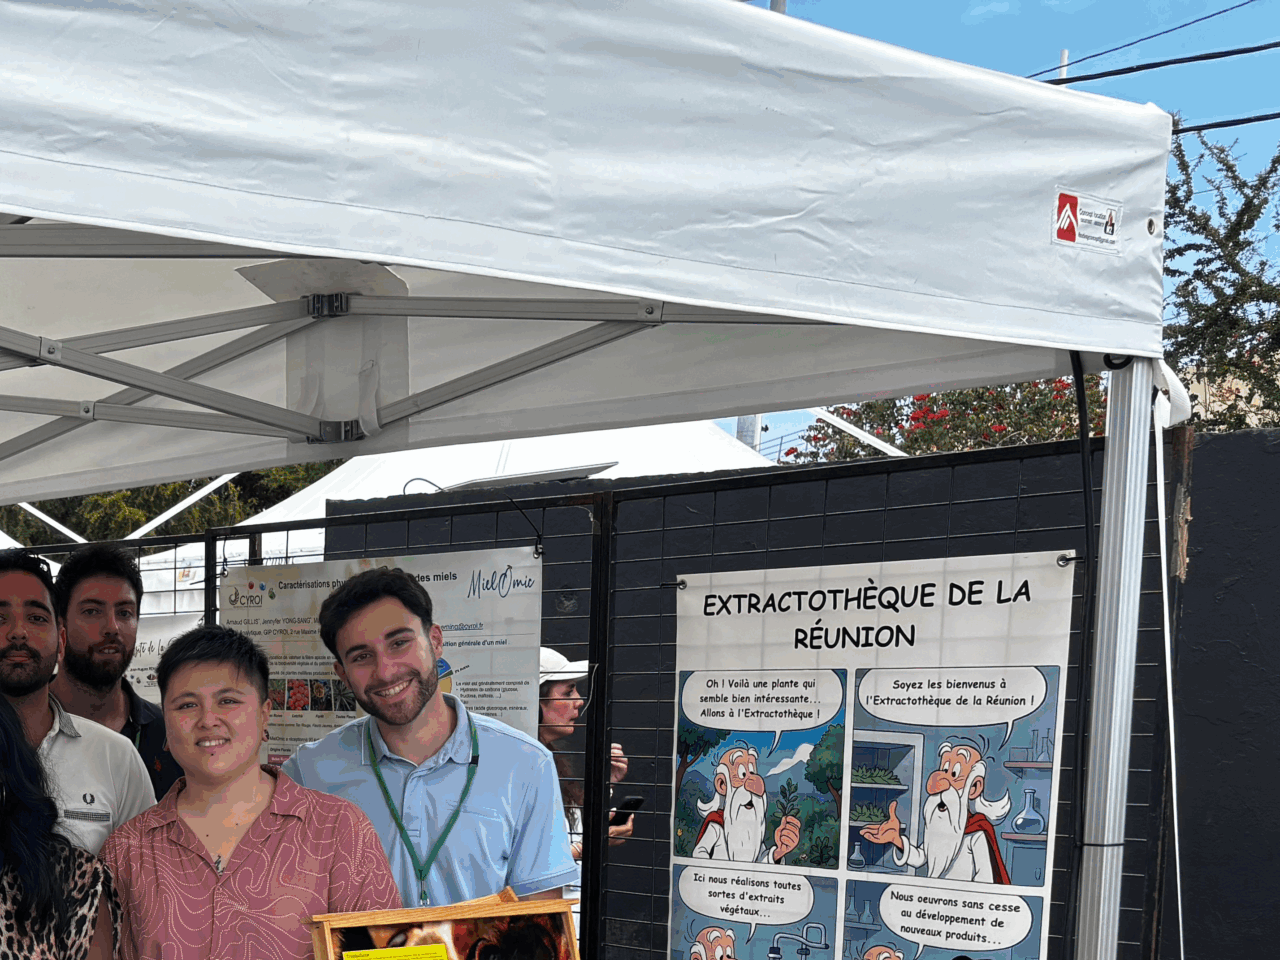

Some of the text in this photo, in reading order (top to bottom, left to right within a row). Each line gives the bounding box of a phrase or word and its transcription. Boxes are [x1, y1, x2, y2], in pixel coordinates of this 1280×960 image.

[433, 572, 457, 582] miels
[278, 580, 330, 590] Caractérisations
[703, 577, 1031, 616] EXTRACTOTHÈQUE DE LA
[794, 618, 916, 650] RÉUNION
[458, 639, 481, 647] générale
[495, 638, 508, 646] miel
[706, 679, 719, 688] Oh
[728, 678, 750, 688] Voilà
[771, 679, 799, 691] plante
[802, 679, 816, 690] qui
[892, 678, 1007, 692] Soyez les bienvenus à
[699, 693, 821, 704] semble bien intéressante...
[866, 694, 1035, 708] l'Extractothèque de la Réunion !
[700, 708, 725, 718] Allons
[728, 708, 734, 718] à
[738, 708, 814, 721] l'Extractothèque
[693, 873, 802, 891] Ici nous réalisons toutes
[708, 890, 785, 904] sortes d'extraits
[890, 890, 1021, 913] Nous oeuvrons sans cesse
[720, 903, 771, 918] végétaux...
[901, 909, 1005, 928] au développement de
[900, 925, 1001, 945] nouveaux produits...
